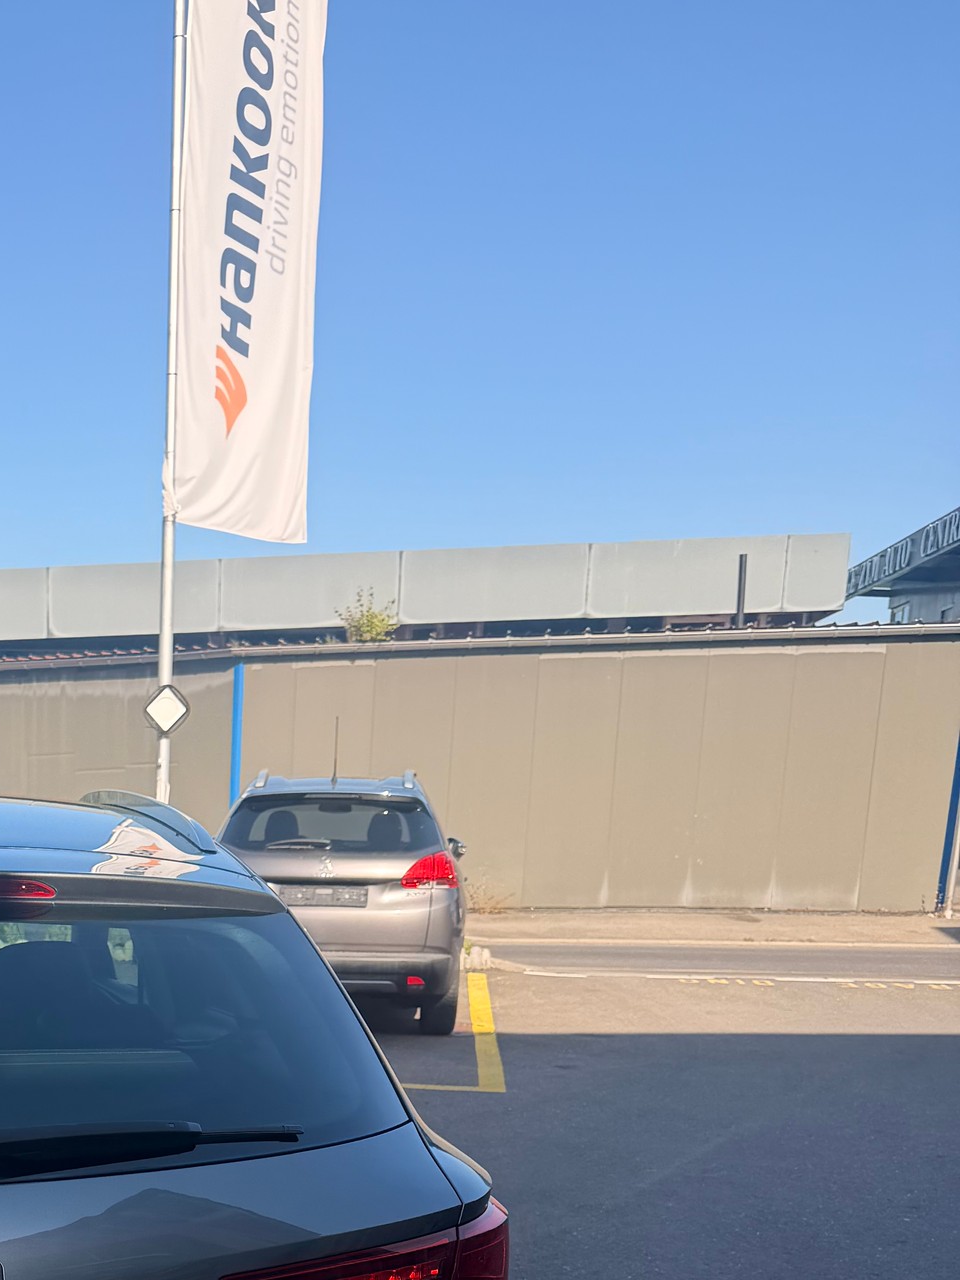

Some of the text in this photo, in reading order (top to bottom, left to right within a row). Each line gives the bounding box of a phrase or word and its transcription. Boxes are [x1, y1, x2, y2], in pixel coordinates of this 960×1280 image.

[265, 0, 302, 276] driving emotion
[920, 511, 960, 557] CENTR
